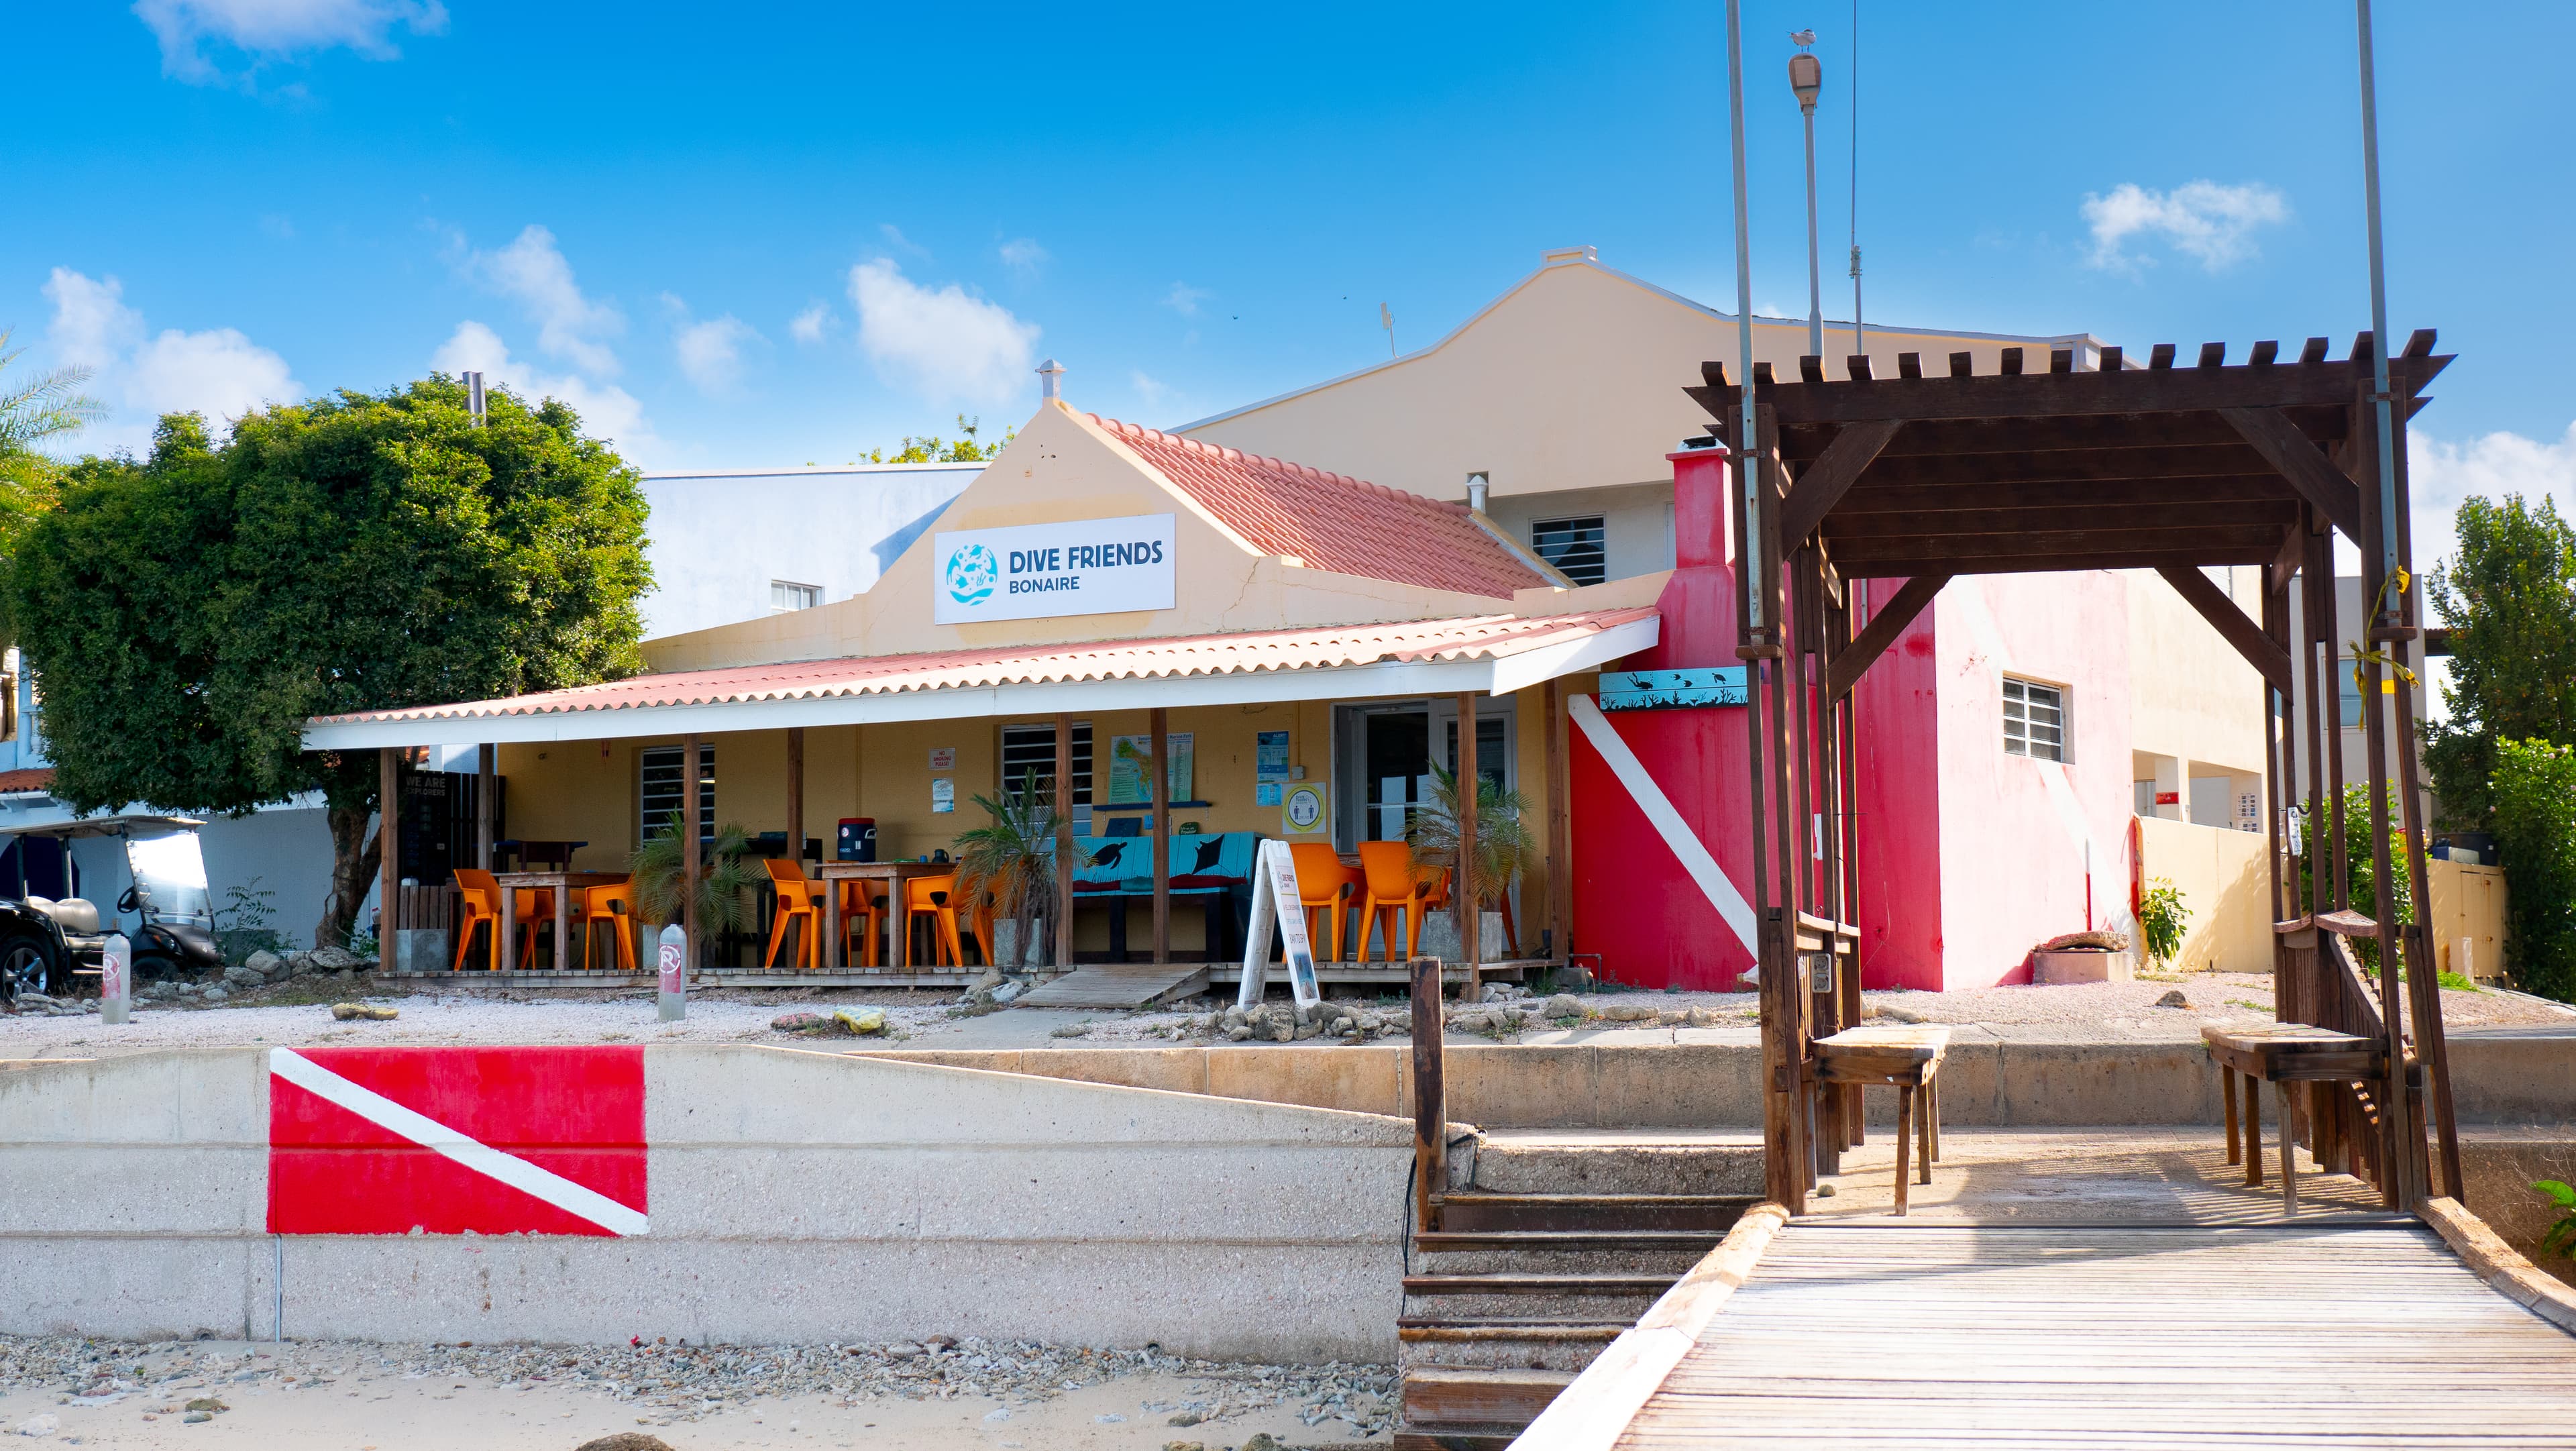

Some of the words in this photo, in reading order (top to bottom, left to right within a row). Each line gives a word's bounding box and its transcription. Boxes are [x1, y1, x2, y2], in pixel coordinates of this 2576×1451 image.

[1010, 548, 1060, 574] DIVE
[1068, 540, 1163, 570] FRIENDS
[1010, 576, 1080, 594] BONAIRE
[405, 776, 423, 787] WE
[425, 777, 446, 788] ARE
